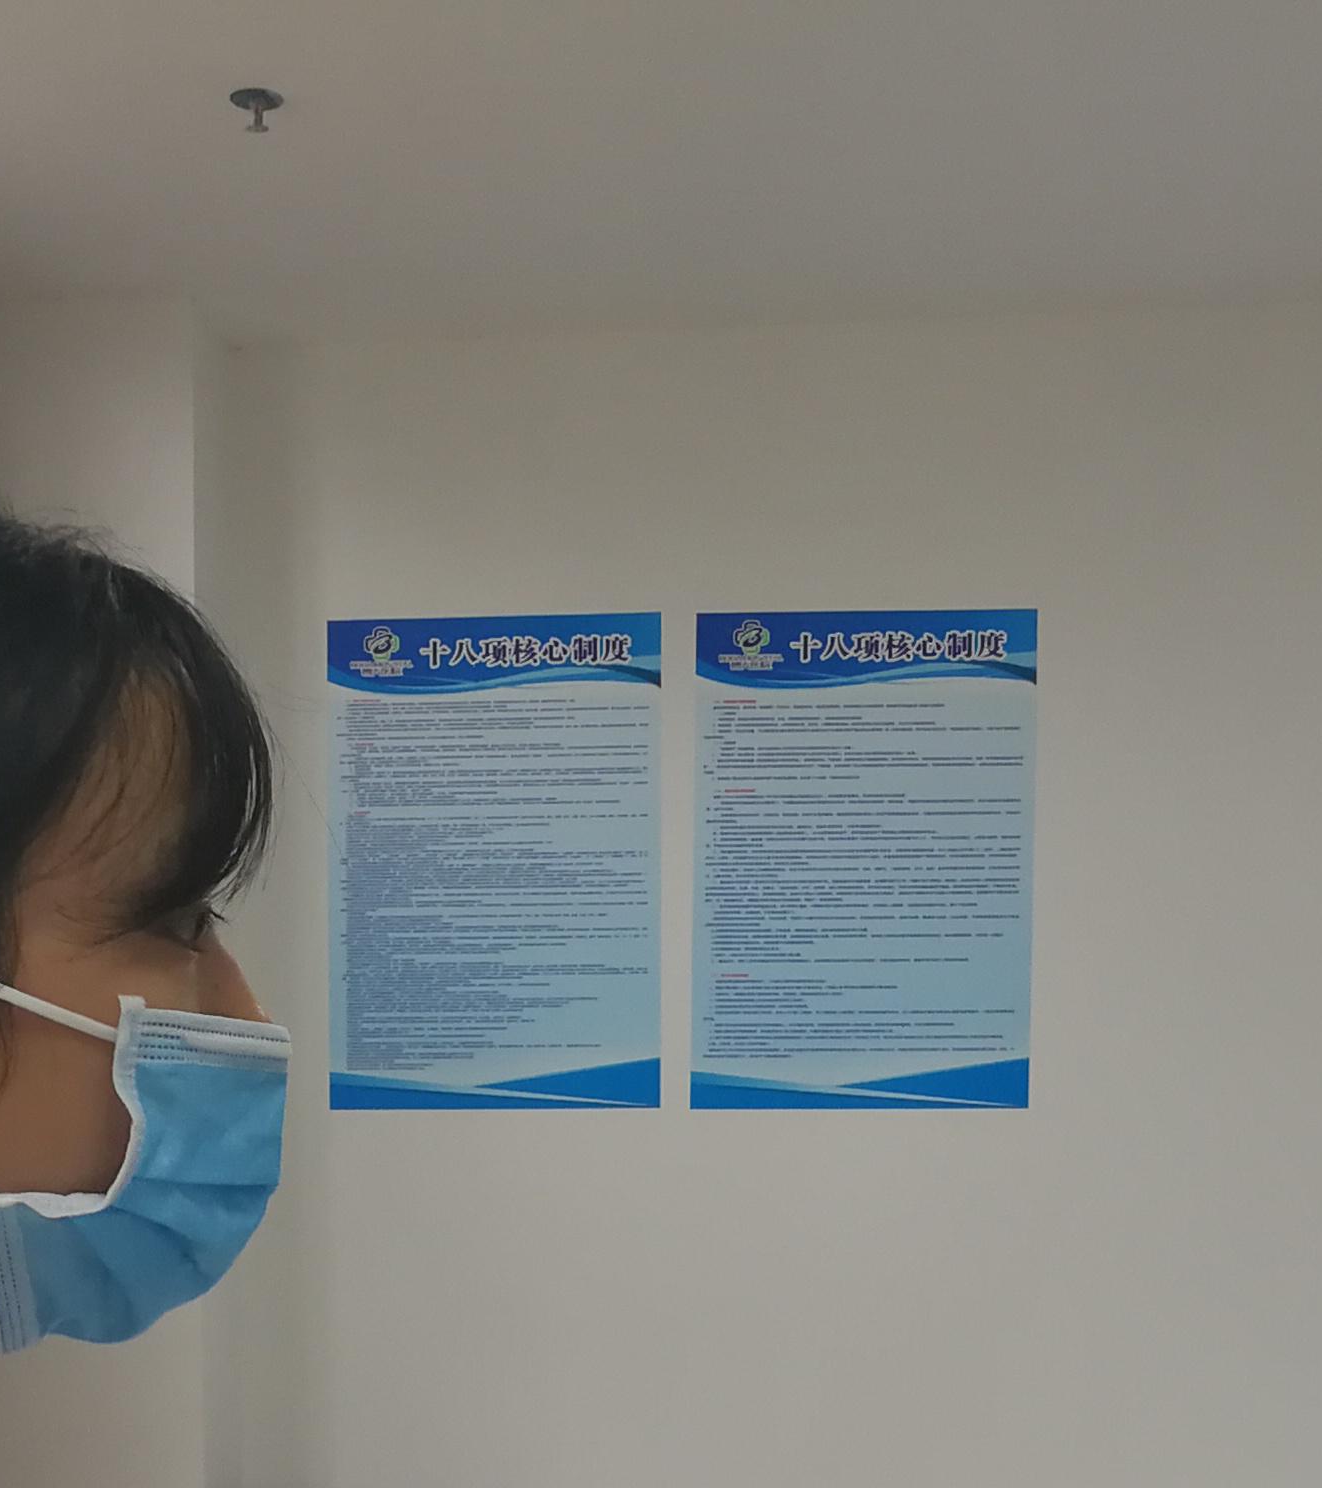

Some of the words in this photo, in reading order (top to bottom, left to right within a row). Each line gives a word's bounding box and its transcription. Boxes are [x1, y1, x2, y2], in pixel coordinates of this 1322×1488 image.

[420, 635, 631, 668] 十八项核心制度
[790, 629, 1008, 663] 十八项核心制度
